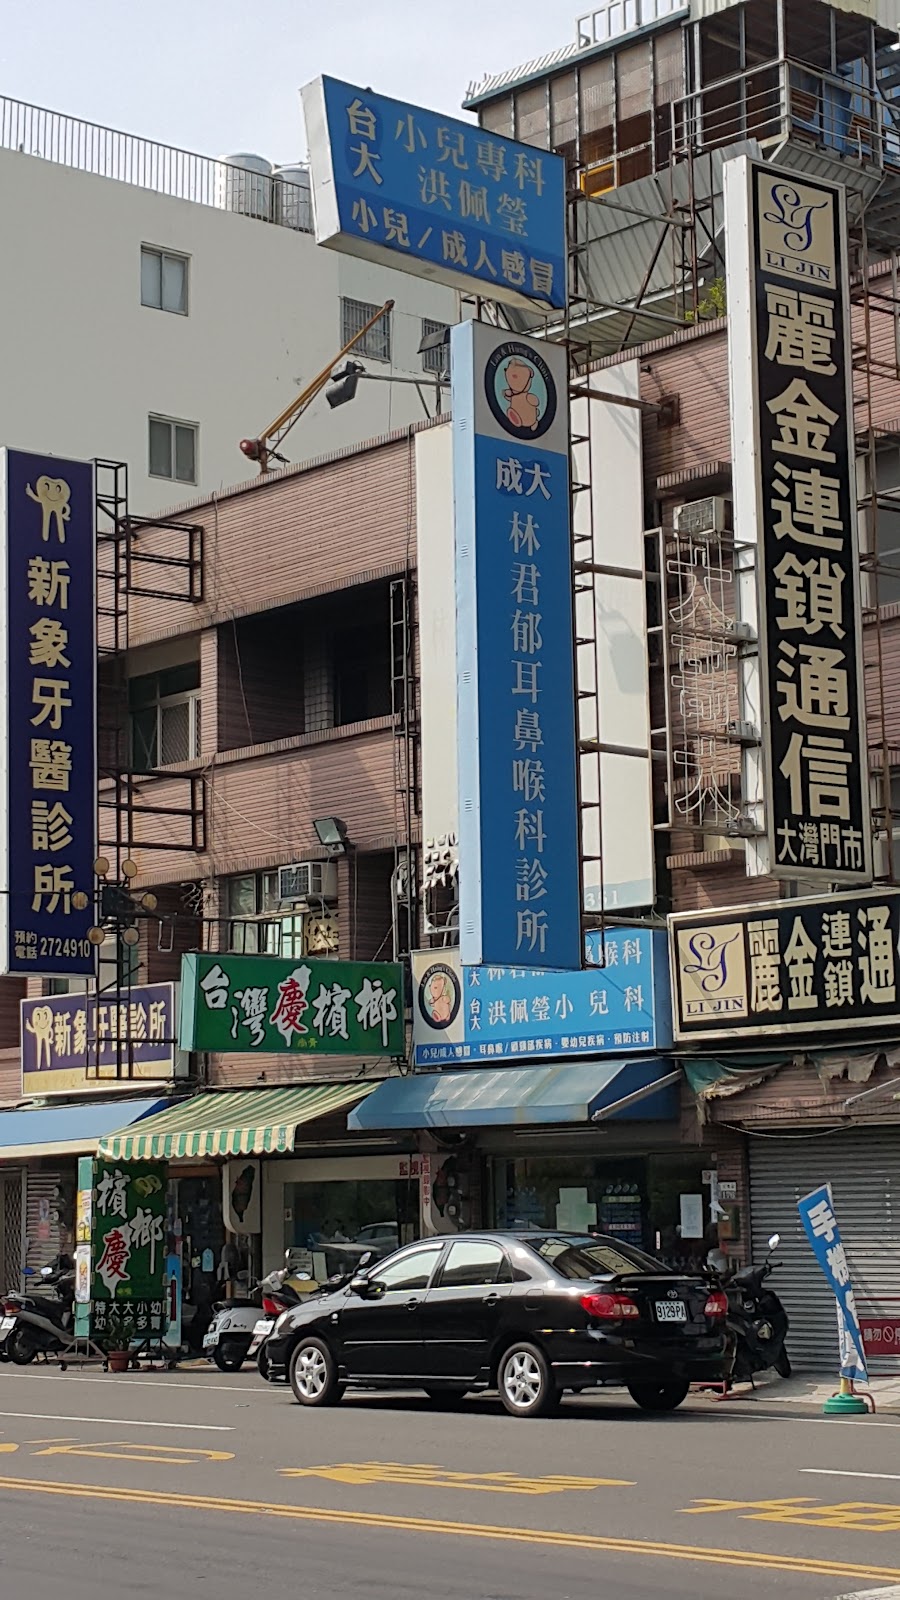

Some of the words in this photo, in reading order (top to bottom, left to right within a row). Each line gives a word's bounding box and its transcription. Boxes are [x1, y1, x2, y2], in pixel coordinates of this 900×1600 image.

[346, 99, 383, 185] 台大
[395, 114, 545, 196] 小兒專科
[418, 165, 529, 238] 洪佩瑩
[352, 197, 554, 297] 小兒/成人感冒
[766, 252, 787, 269] LI
[795, 261, 831, 281] JIN
[495, 457, 552, 500] 成大
[763, 283, 852, 820] 麗金連鎖通信
[27, 557, 76, 915] 新象牙醫診所
[508, 510, 549, 954] 林君郁耳鼻喉科診所
[777, 819, 862, 869] 大灣門市
[15, 930, 37, 944] 預約
[40, 937, 90, 957] 2724910
[747, 906, 900, 1013] 麗金連鎖通
[54, 1001, 166, 1057] 新象牙醫診所
[470, 998, 481, 1031] 台大
[687, 1002, 704, 1014] LI
[713, 999, 743, 1011] JIN
